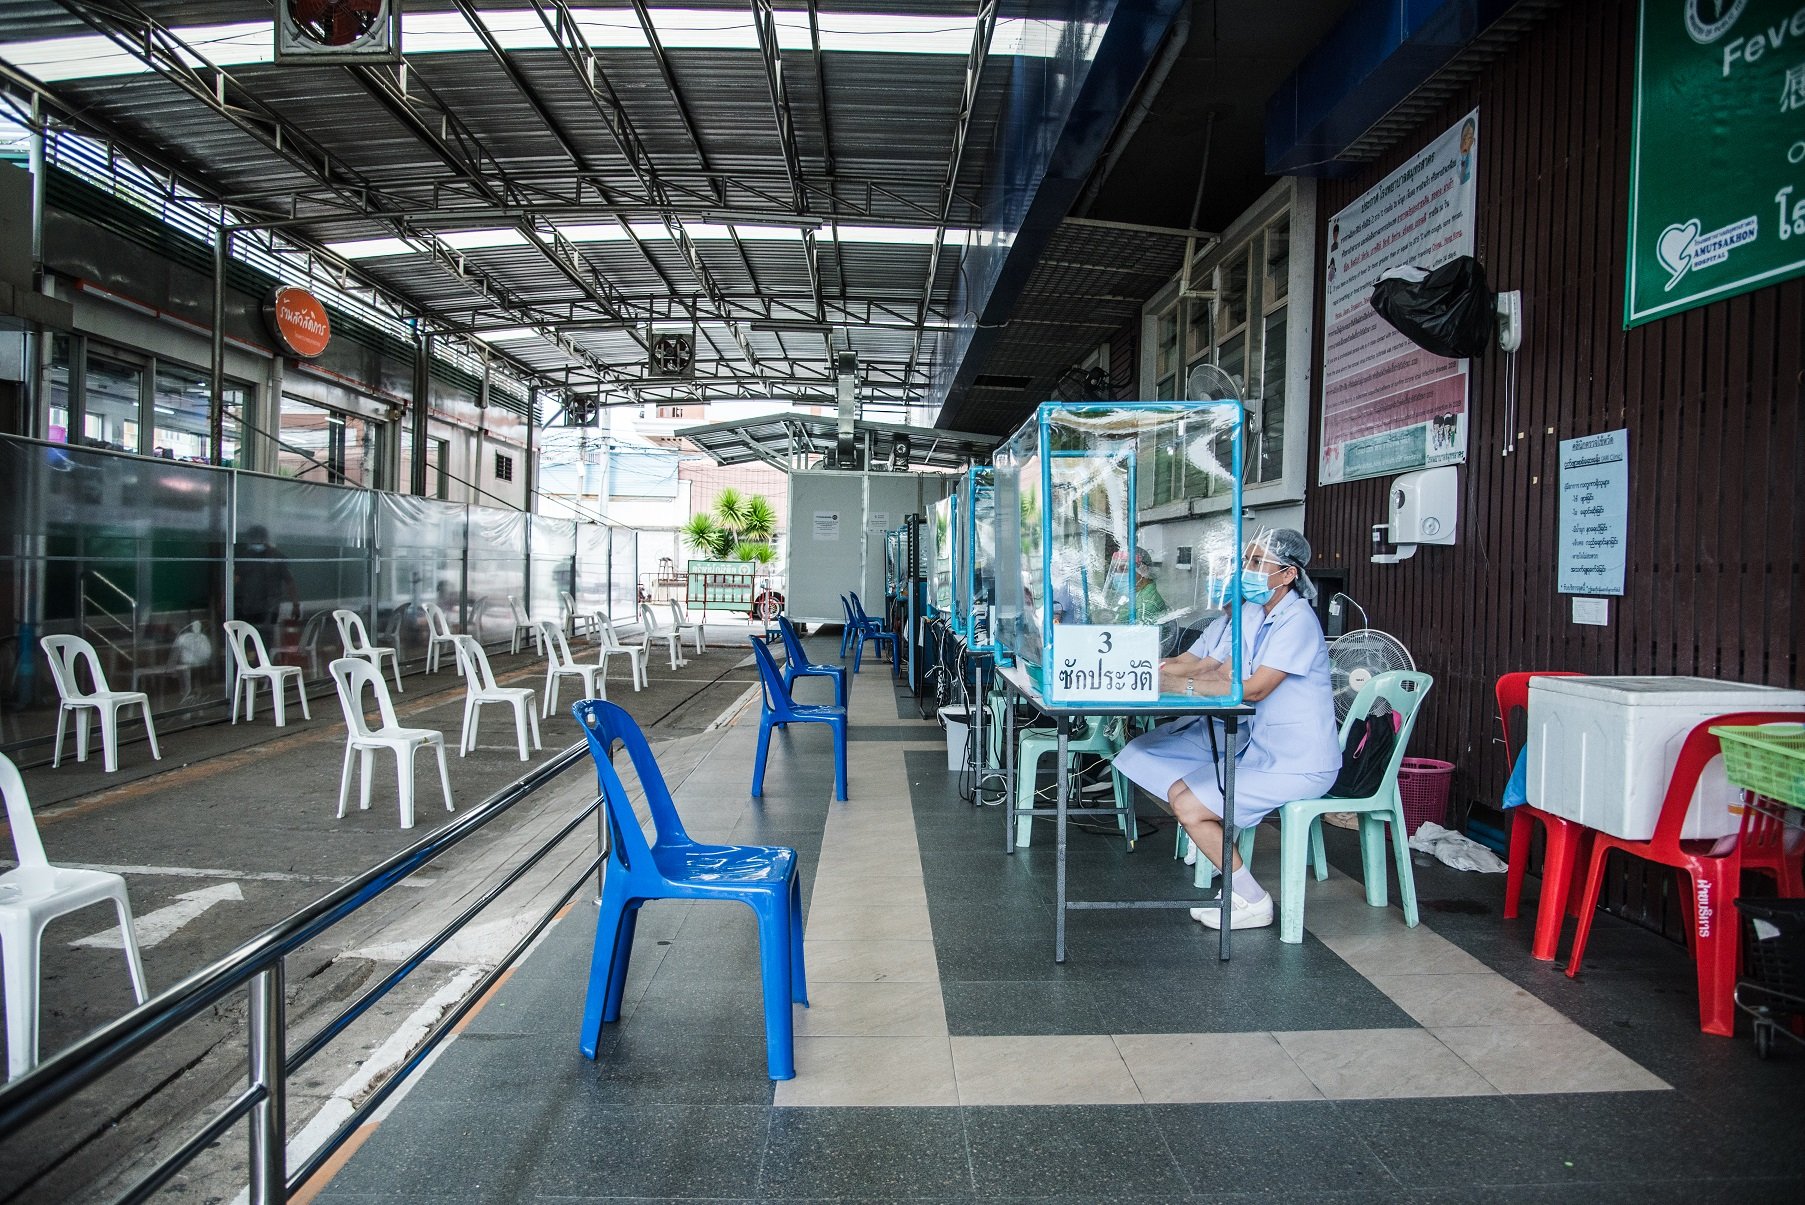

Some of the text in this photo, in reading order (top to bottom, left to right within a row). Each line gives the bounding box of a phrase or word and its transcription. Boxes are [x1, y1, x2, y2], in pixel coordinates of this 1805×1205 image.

[1693, 252, 1726, 268] HOSPITAL
[280, 297, 326, 336] ร้านสวัสดิการ
[1097, 631, 1113, 654] 3
[1059, 658, 1153, 691] ซักประวัติ
